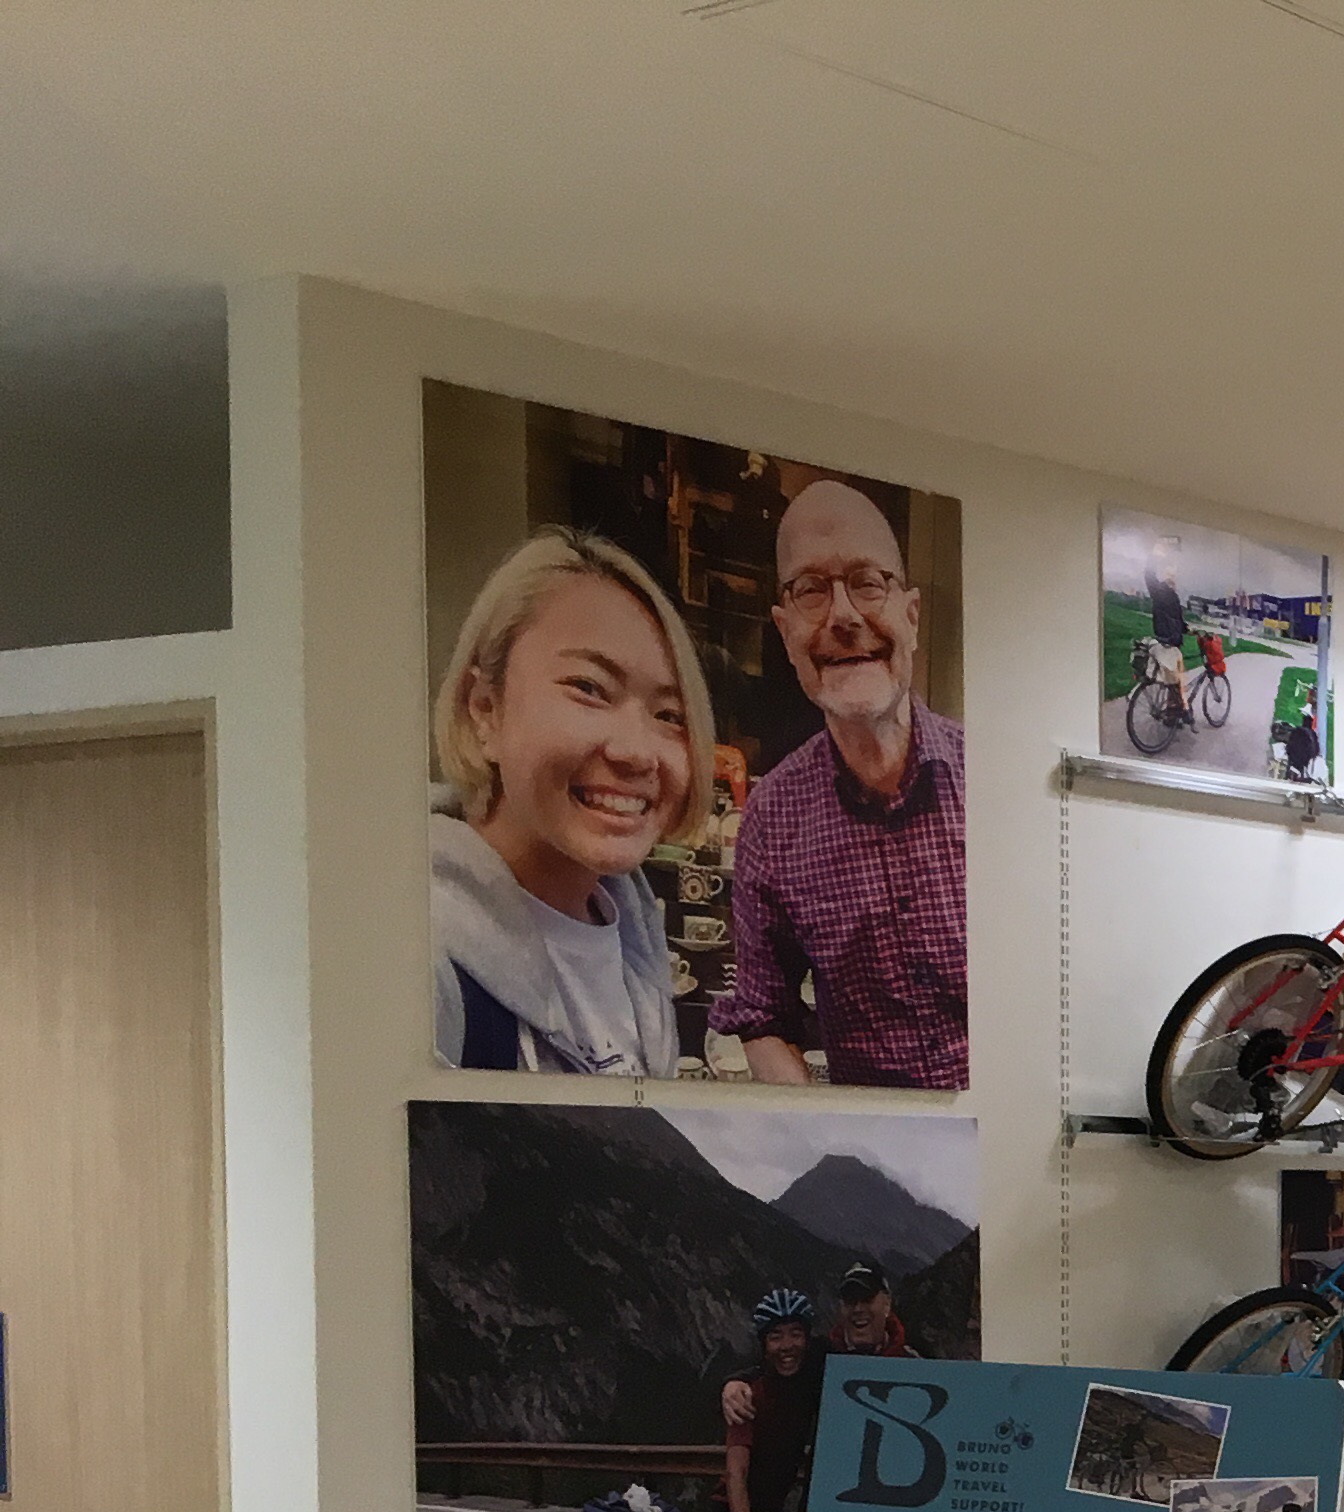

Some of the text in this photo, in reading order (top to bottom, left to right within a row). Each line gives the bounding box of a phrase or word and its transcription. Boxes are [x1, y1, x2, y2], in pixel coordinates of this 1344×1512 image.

[957, 1440, 1011, 1455] BRUNO
[955, 1460, 1009, 1474] WORLD
[954, 1479, 1007, 1493] TRAVEL
